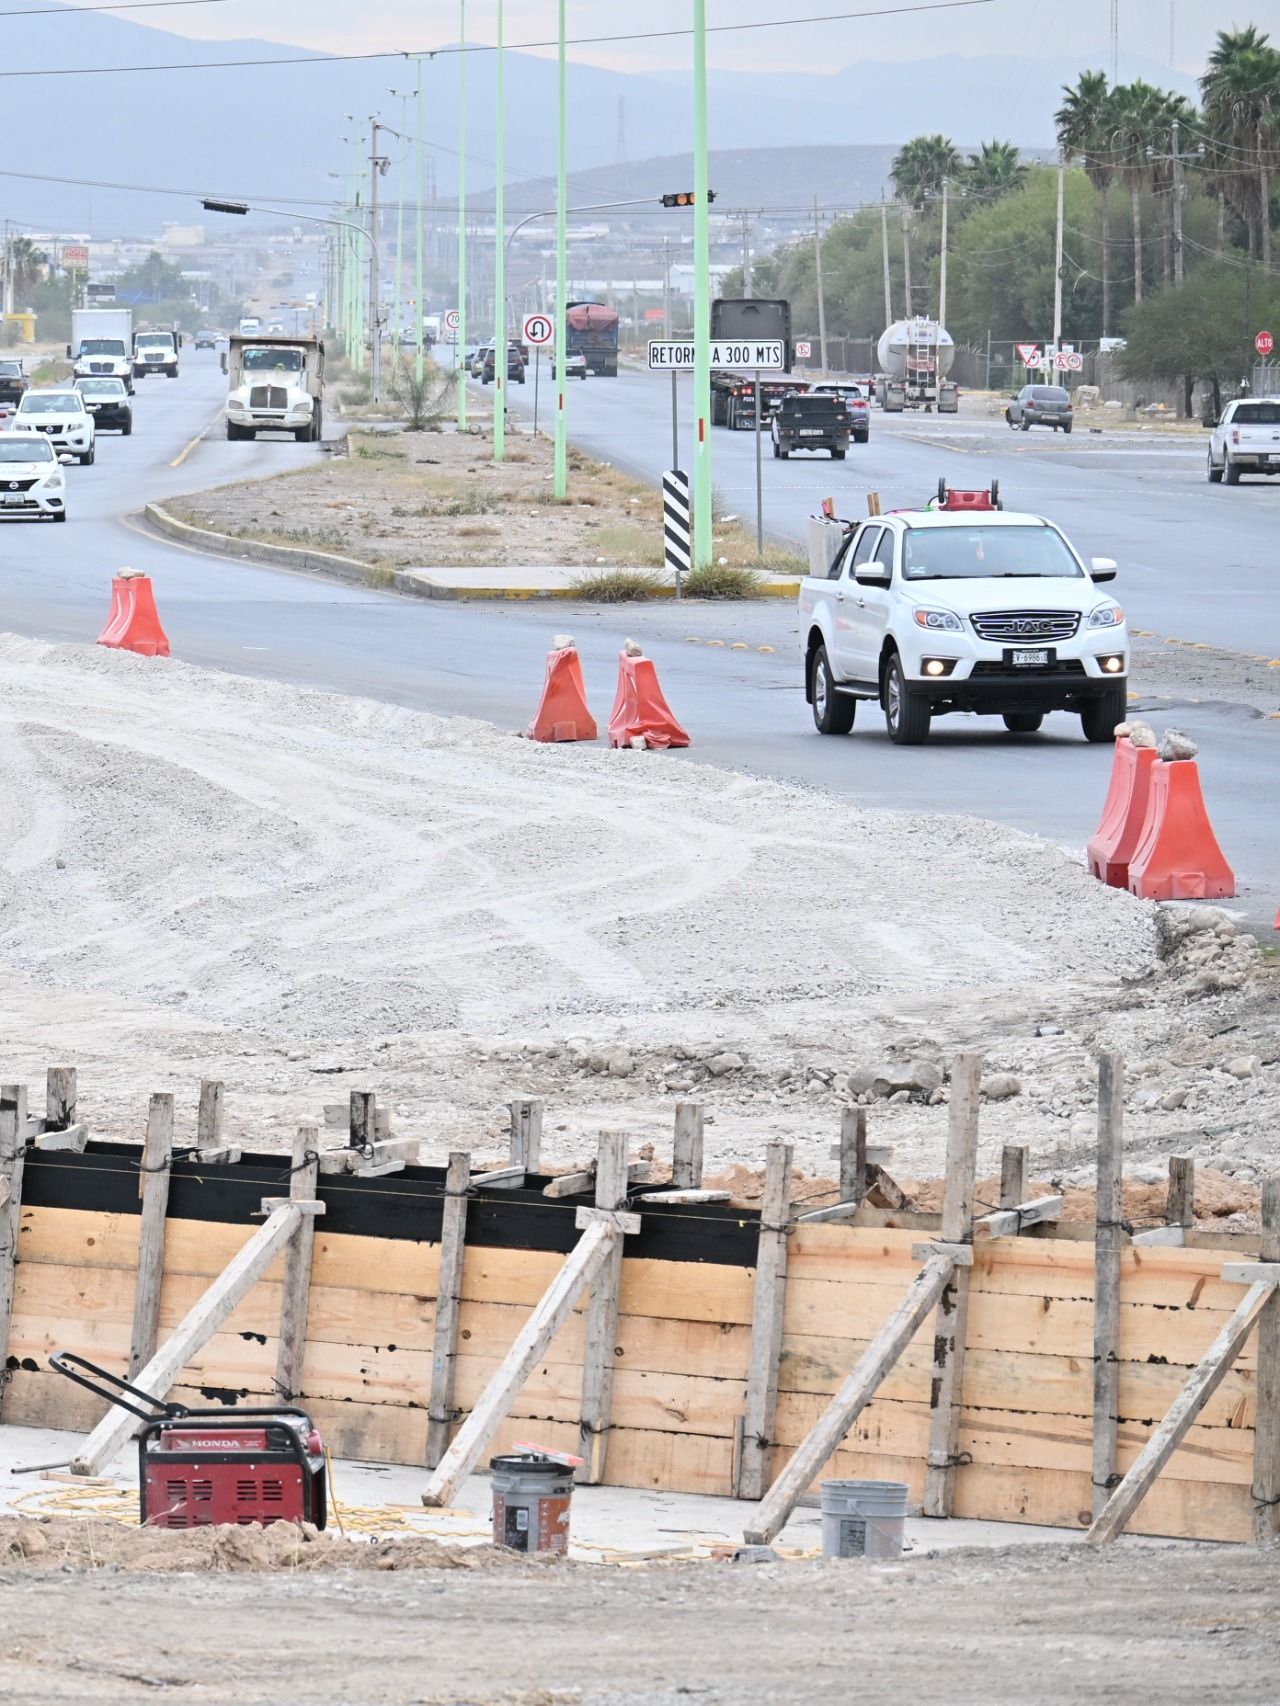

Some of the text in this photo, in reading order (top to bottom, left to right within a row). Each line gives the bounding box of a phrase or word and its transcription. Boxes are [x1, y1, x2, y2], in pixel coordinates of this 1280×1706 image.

[1257, 337, 1272, 348] ALTO
[712, 347, 720, 363] A
[726, 347, 750, 363] 300
[756, 347, 780, 363] MTS
[1004, 619, 1054, 633] JAC
[191, 1440, 240, 1448] HONDA
